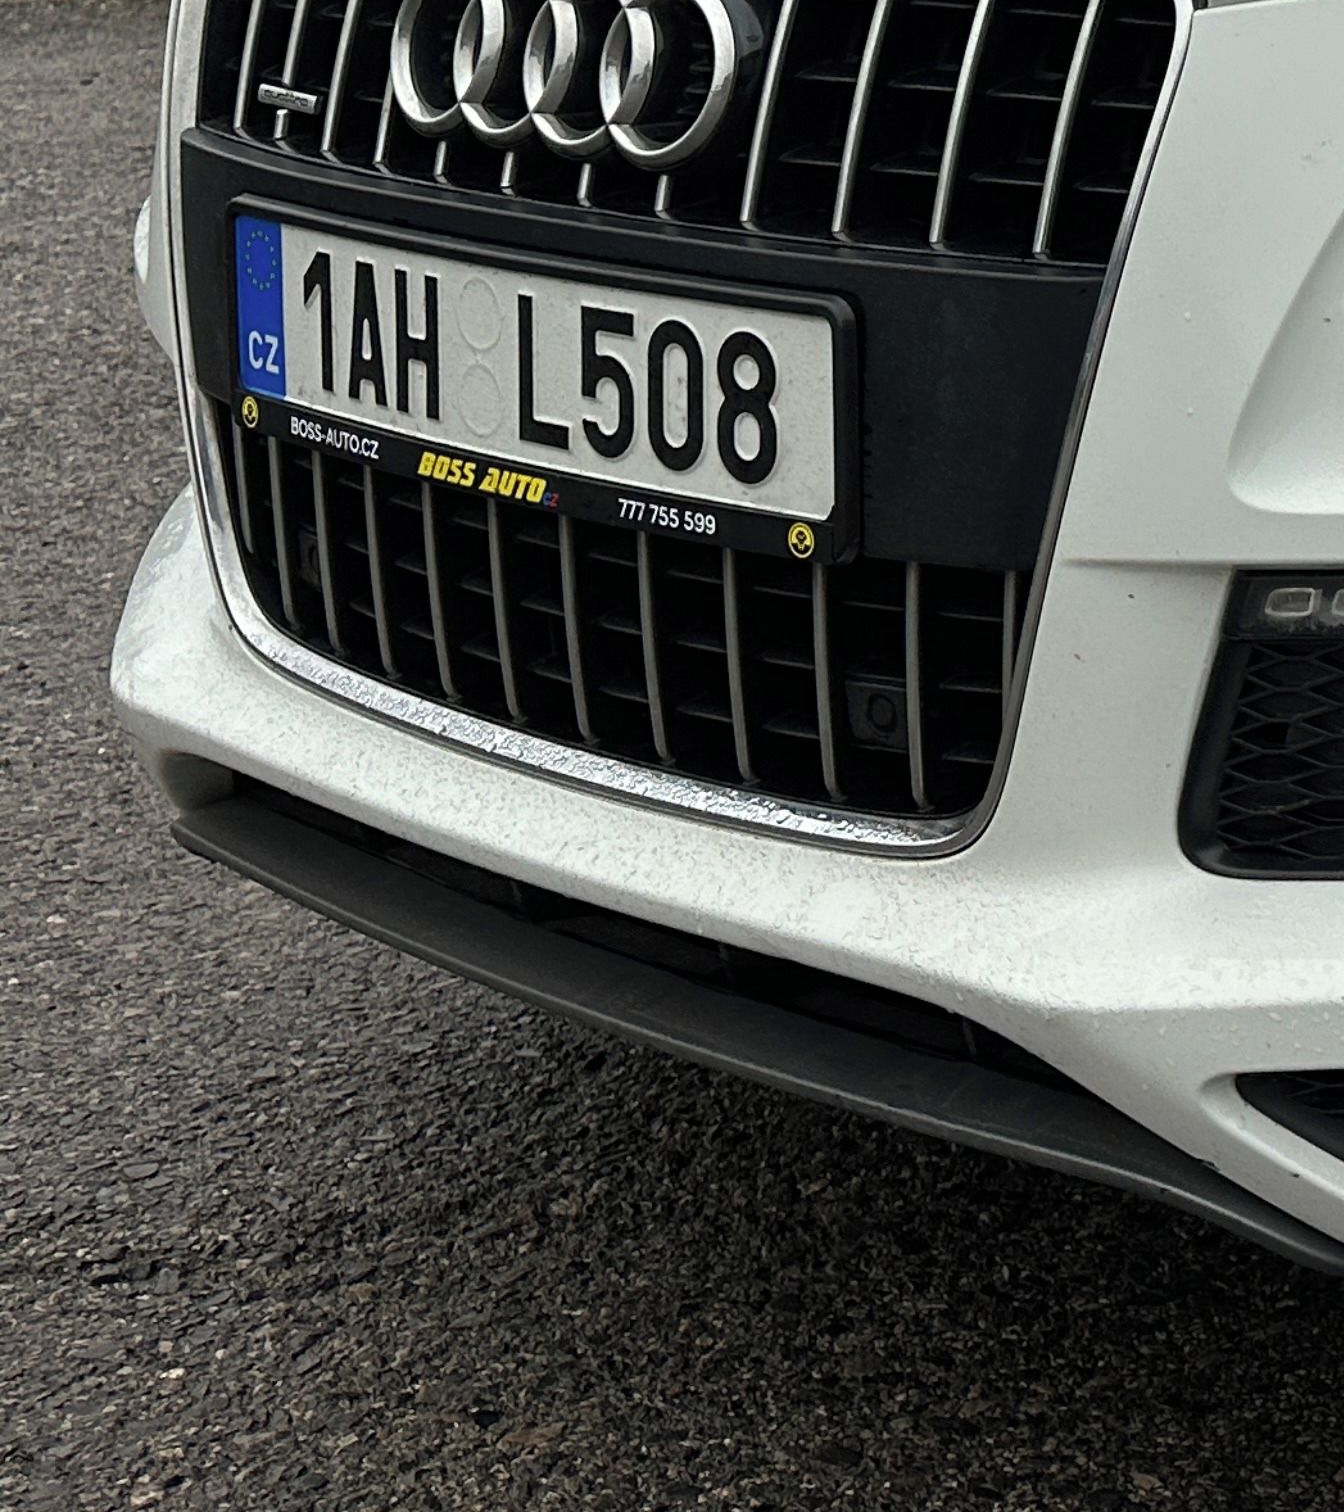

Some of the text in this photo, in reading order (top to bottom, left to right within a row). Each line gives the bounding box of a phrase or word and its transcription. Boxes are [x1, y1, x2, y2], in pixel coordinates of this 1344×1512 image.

[248, 330, 280, 375] CZ
[303, 251, 777, 484] 1AH L508
[291, 416, 379, 460] BOSS-AUTO.CZ
[417, 451, 476, 488] BOSS
[479, 467, 548, 503] AUTO
[618, 498, 716, 535] 777 755 599
